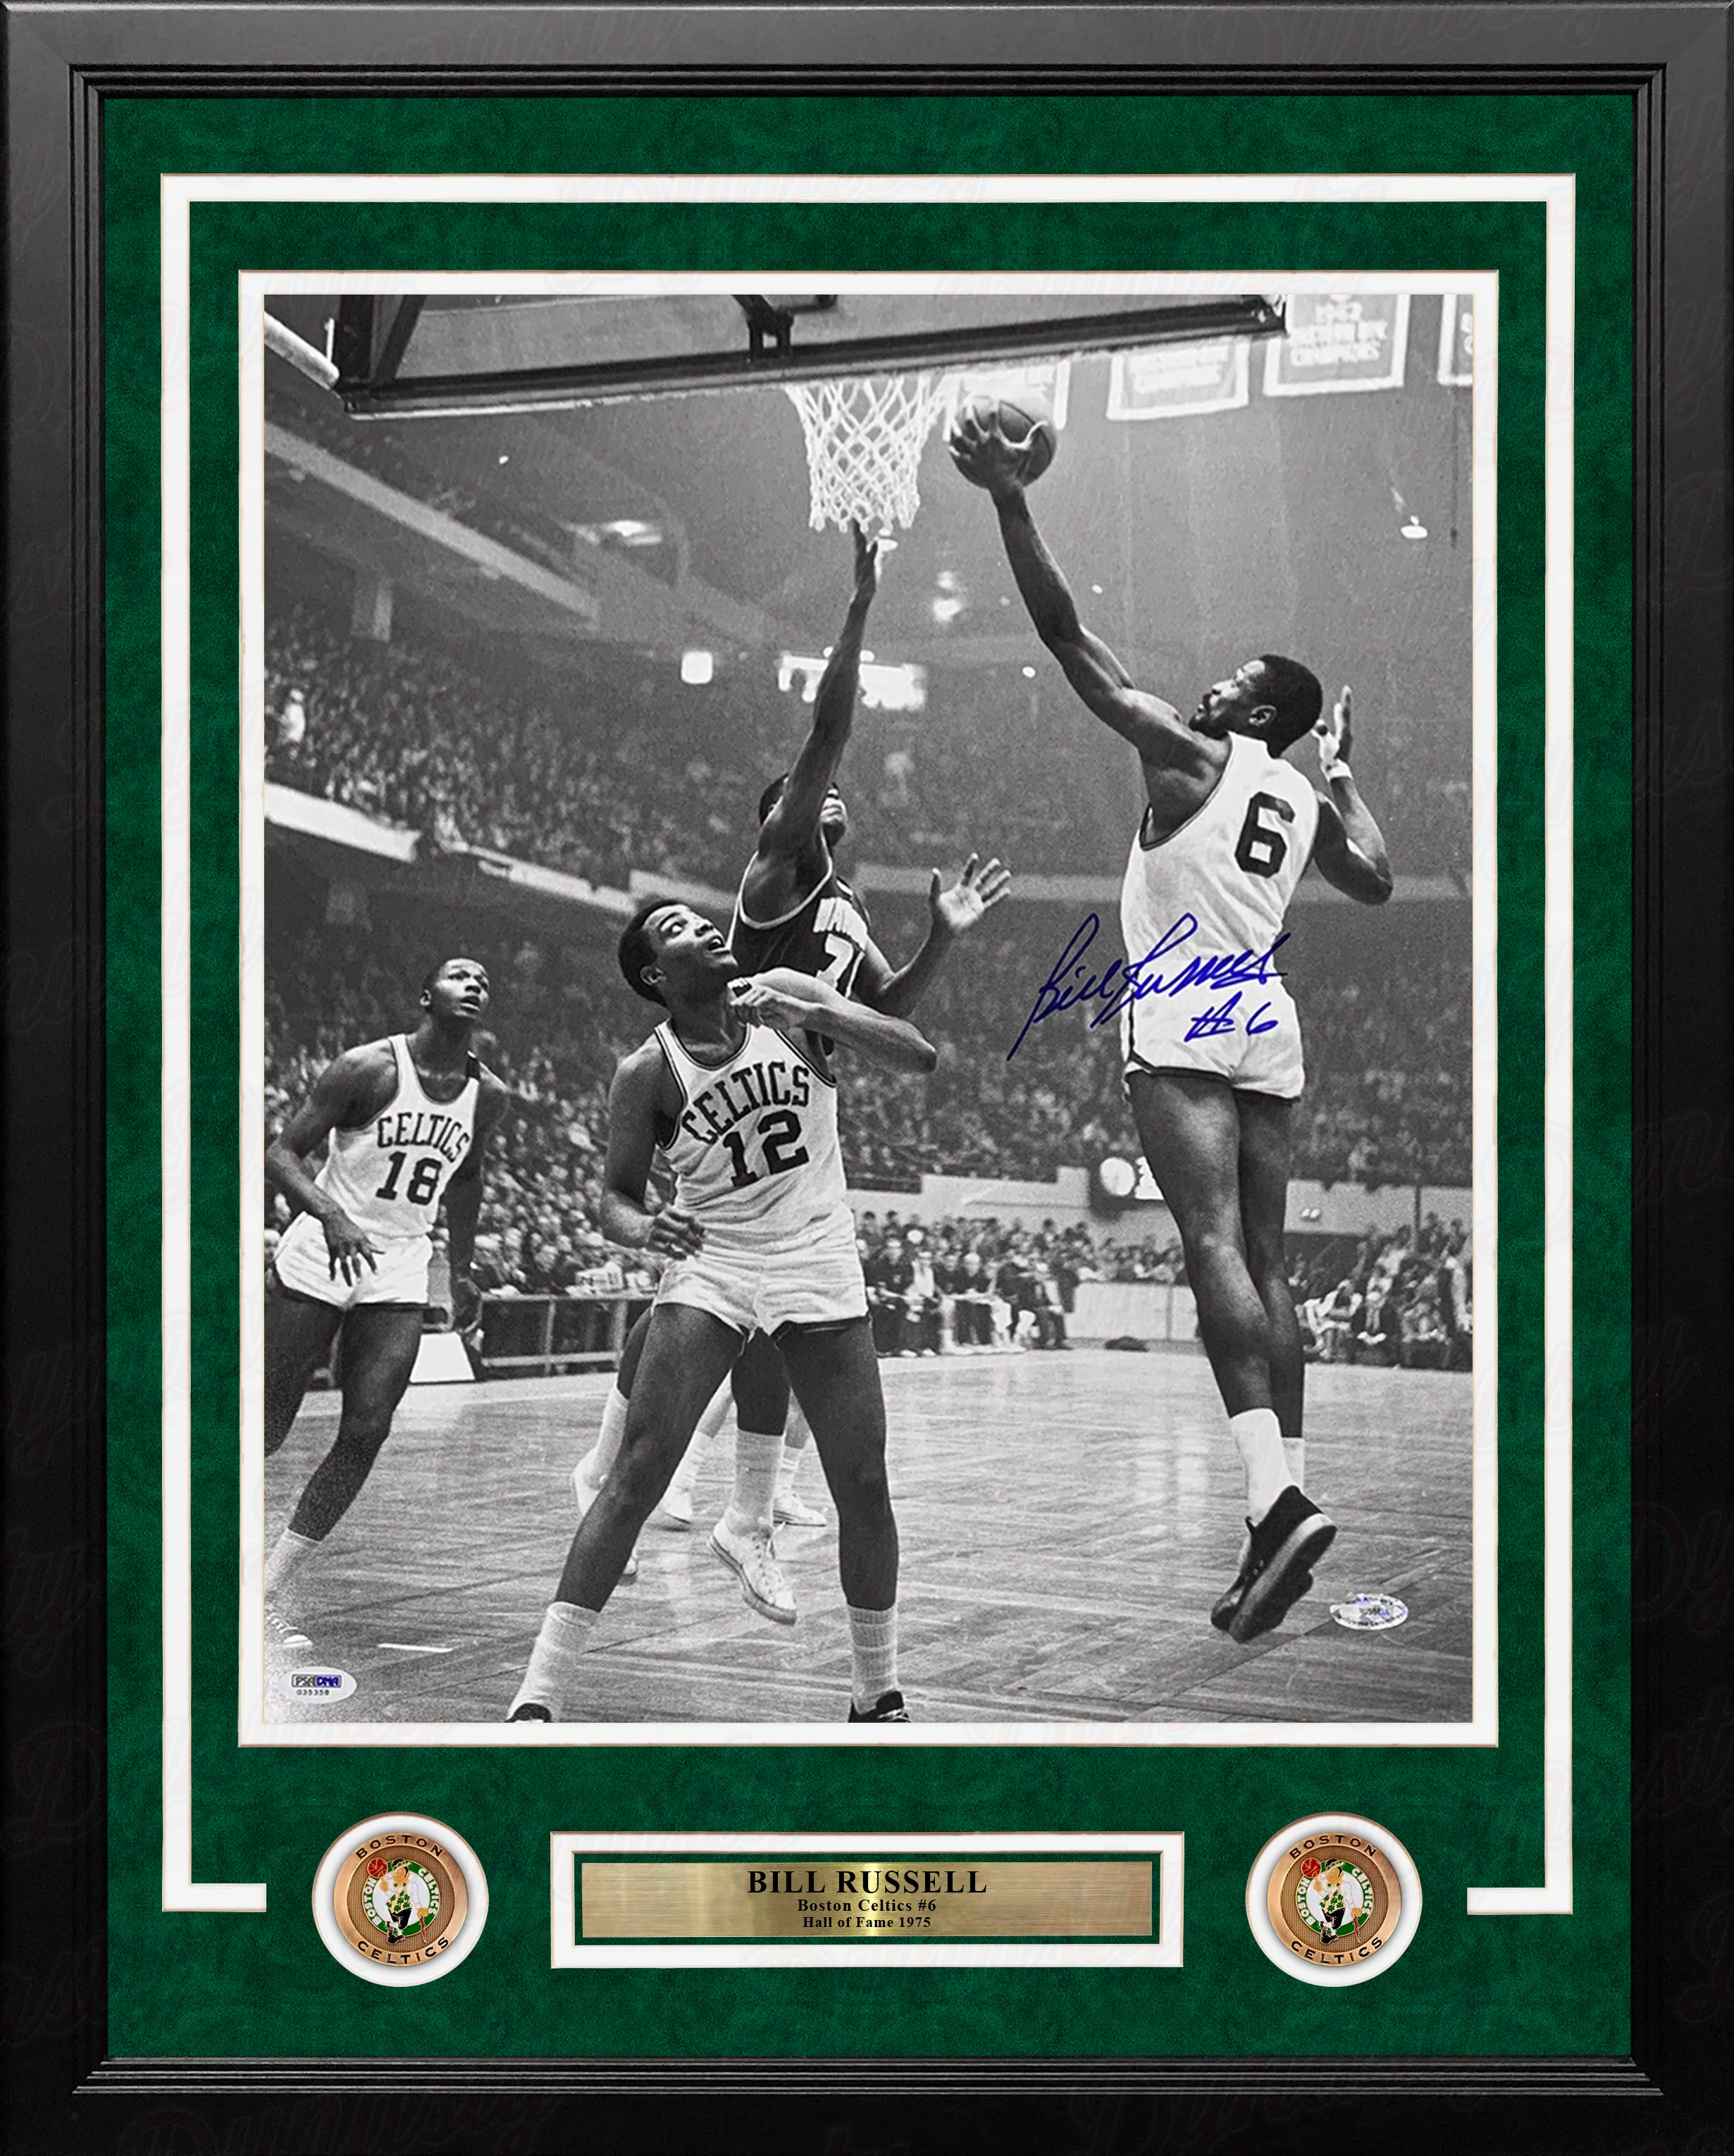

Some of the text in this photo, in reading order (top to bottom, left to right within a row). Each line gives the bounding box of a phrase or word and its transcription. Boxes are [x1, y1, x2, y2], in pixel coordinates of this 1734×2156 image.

[1234, 791, 1296, 879] 6
[681, 1061, 810, 1145] CELTICS
[377, 1112, 470, 1163] CELTICS
[722, 1108, 810, 1187] 12
[376, 1151, 442, 1206] 18
[356, 1835, 444, 1860] BOSTON
[1289, 1835, 1377, 1860] BOSTON
[364, 1877, 383, 1926] BOSTON
[419, 1867, 440, 1915] CELTICS
[747, 1871, 987, 1894] BILL RUSSELL
[798, 1898, 936, 1912] Boston Celtics #6
[1297, 1877, 1316, 1926] BOSTON
[1352, 1867, 1373, 1915] CELTICS
[803, 1916, 931, 1928] Hall of Fame 1975
[357, 1936, 450, 1964] CELTICS
[1291, 1936, 1383, 1964] CELTICS
